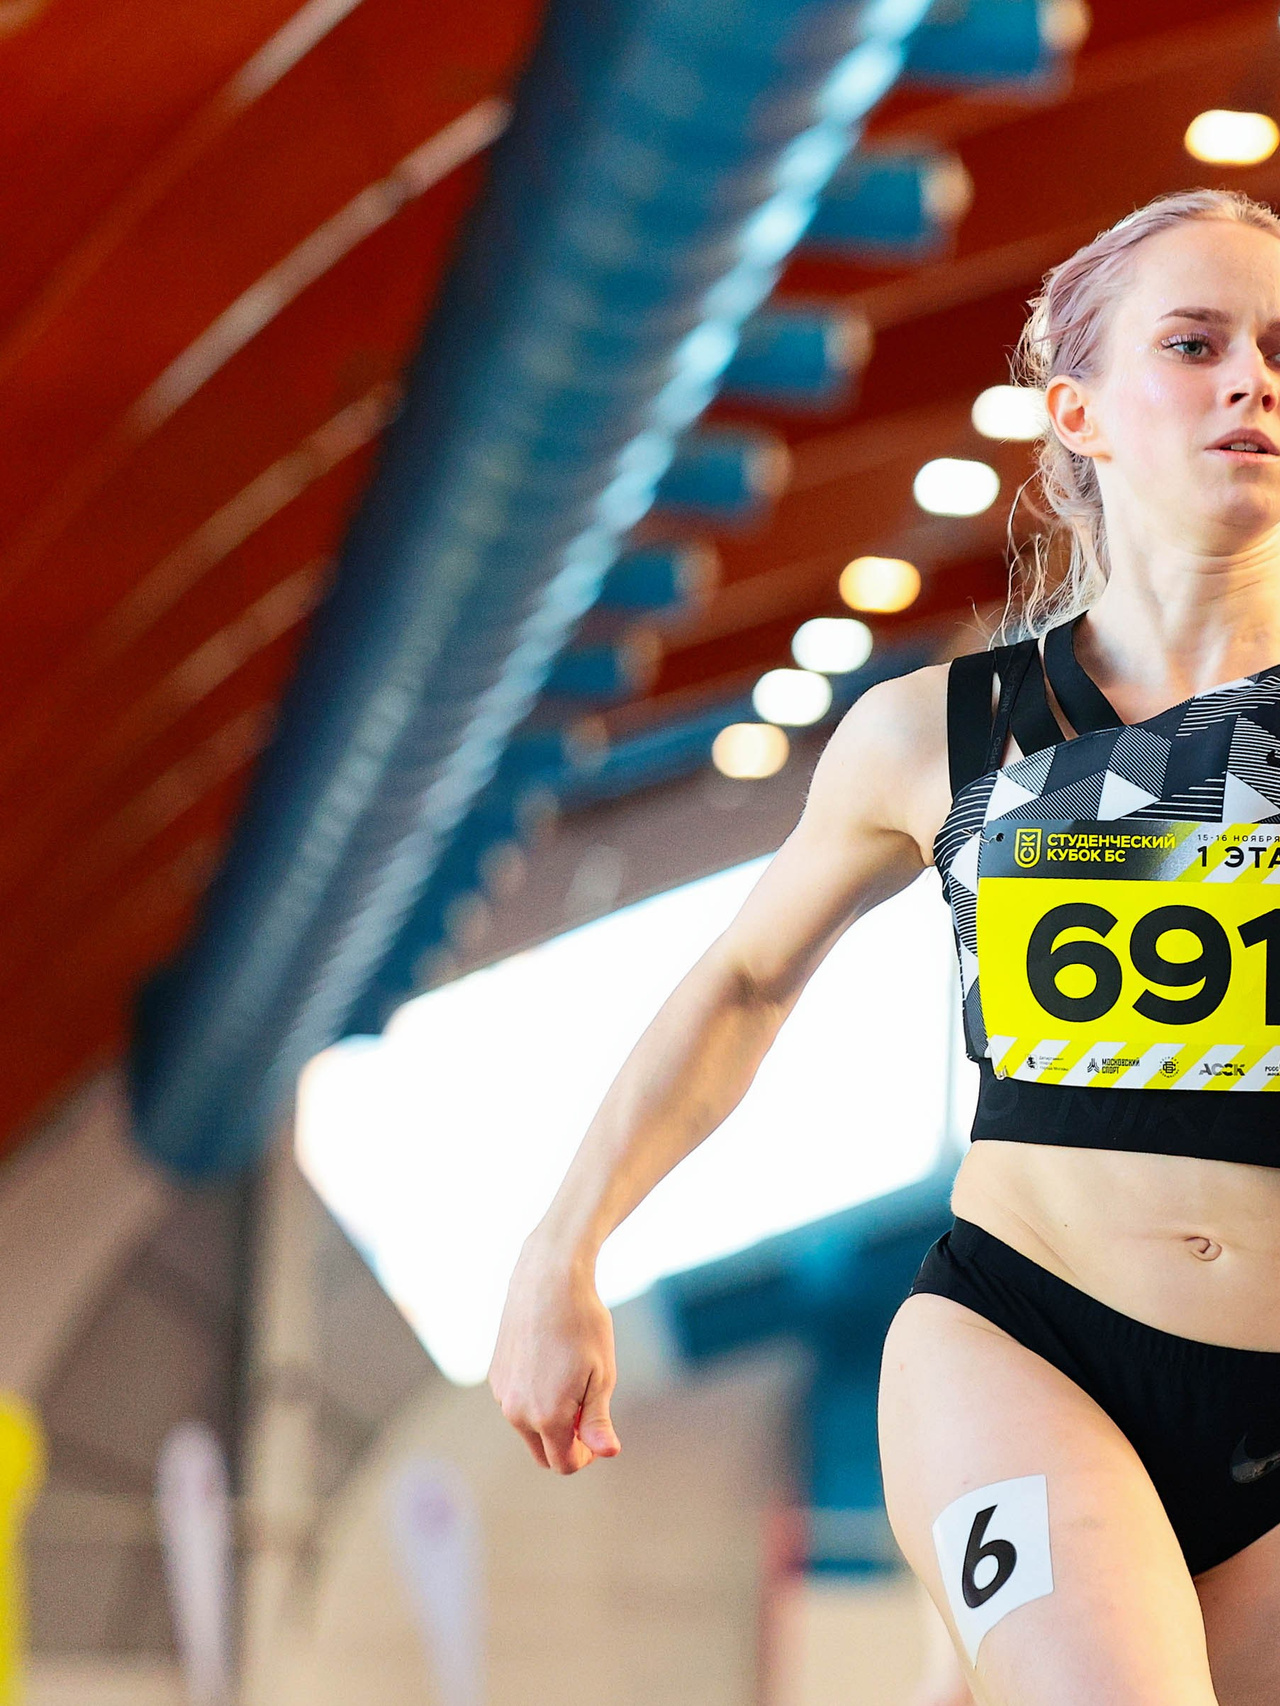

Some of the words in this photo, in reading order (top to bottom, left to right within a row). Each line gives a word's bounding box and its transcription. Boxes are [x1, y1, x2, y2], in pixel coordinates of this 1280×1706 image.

[1046, 833, 1177, 849] СТУДЕНЧЕСКИЙ
[1197, 834, 1228, 842] 15-16
[1233, 835, 1280, 843] НОЯБРЯ
[1046, 848, 1102, 862] КУБОК
[1104, 850, 1127, 863] БС
[1197, 845, 1208, 868] 1
[1101, 1057, 1141, 1067] МОСКОВСКИЙ
[1101, 1066, 1120, 1074] СПОРТ
[962, 1504, 1018, 1610] 6
